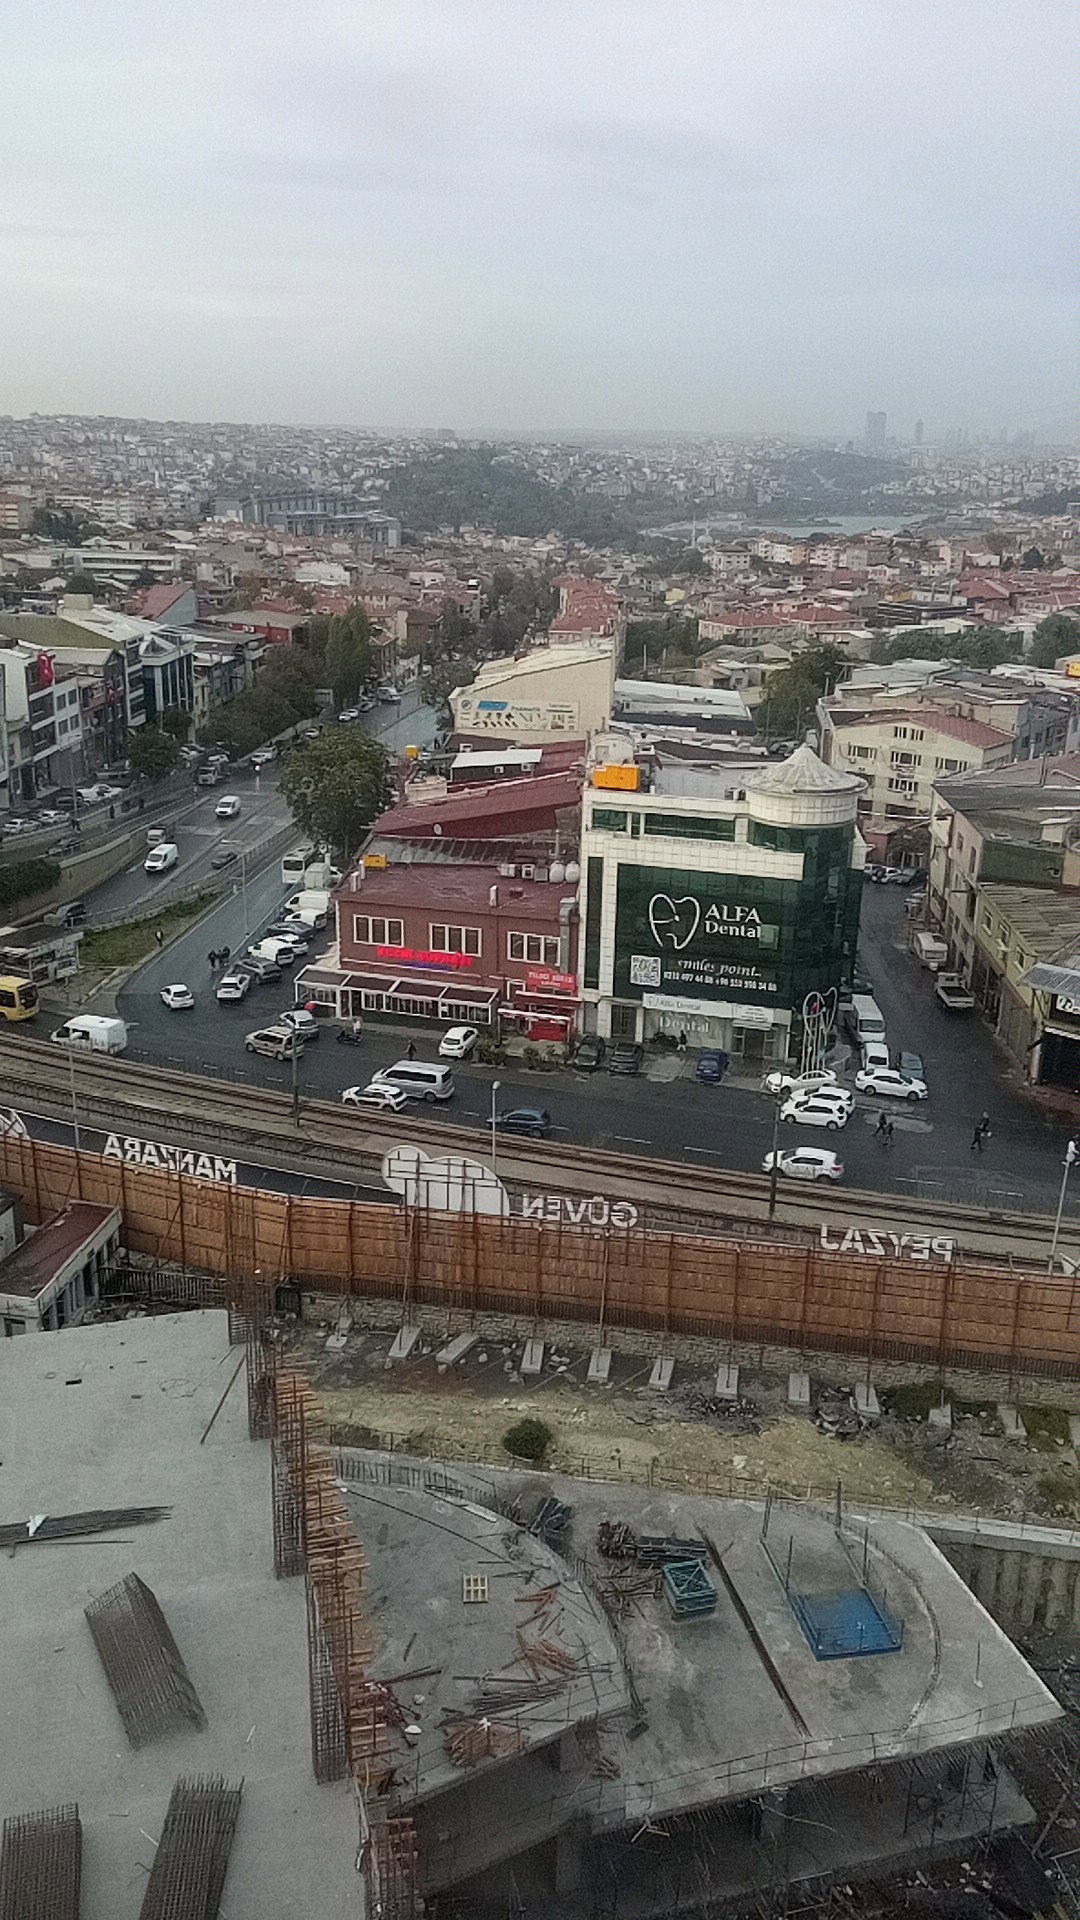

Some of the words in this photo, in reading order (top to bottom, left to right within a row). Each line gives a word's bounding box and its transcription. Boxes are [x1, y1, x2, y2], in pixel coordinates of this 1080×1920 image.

[704, 903, 762, 924] ALFA
[704, 921, 762, 939] Dental
[659, 1015, 710, 1034] Dental
